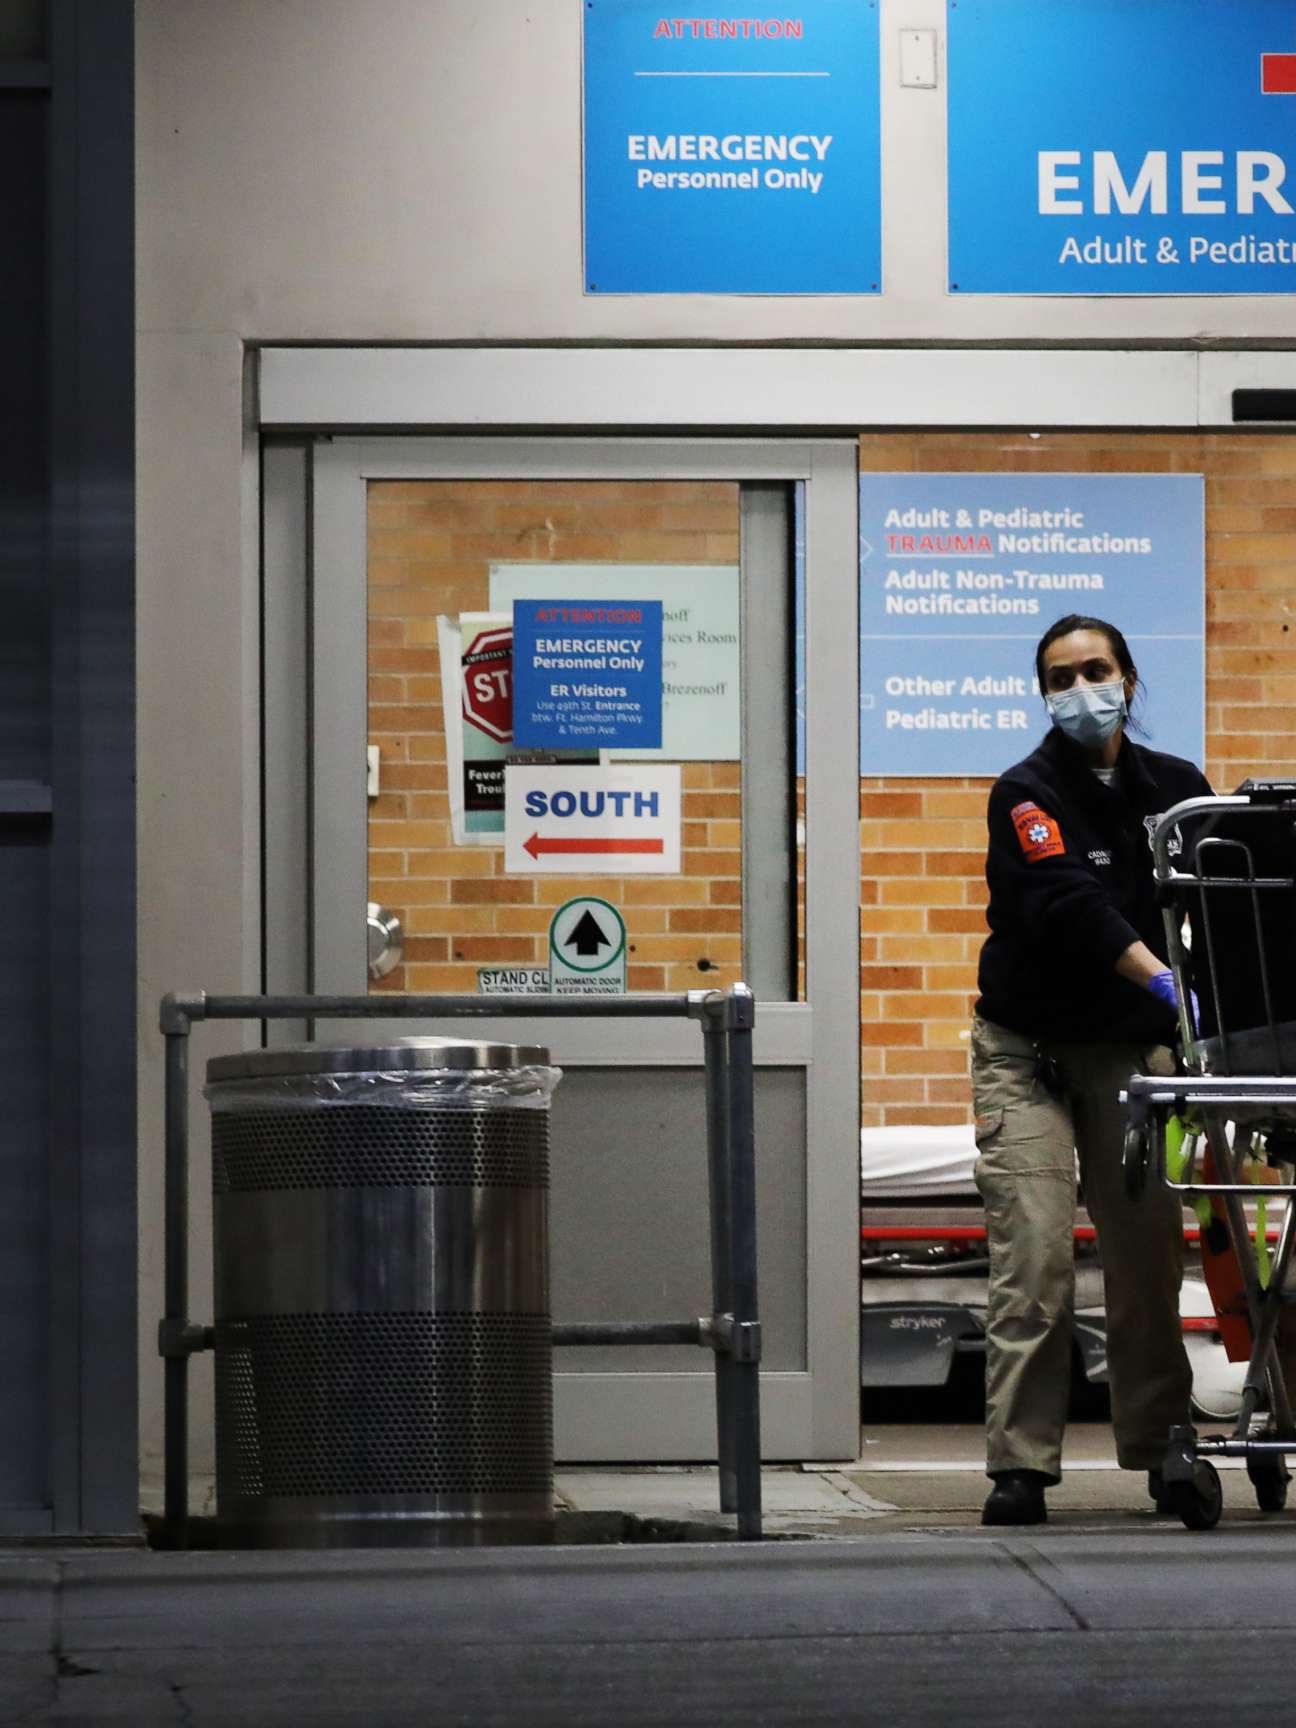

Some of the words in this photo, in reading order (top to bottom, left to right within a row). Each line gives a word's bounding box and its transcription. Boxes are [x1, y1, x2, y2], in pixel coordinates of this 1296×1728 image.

[654, 18, 803, 39] ATTENTION
[629, 135, 832, 160] EMERGENCY
[638, 168, 759, 188] Personnel
[764, 168, 823, 193] Only
[1059, 236, 1147, 264] Adult
[1156, 237, 1179, 263] &
[884, 508, 950, 528] Adult
[956, 509, 972, 528] &
[979, 508, 1083, 528] Pediatric
[885, 534, 992, 553] TRAUMA
[999, 533, 1151, 553] Notifications
[884, 569, 950, 589] Adult
[956, 570, 1104, 589] Non-Trauma
[886, 593, 1039, 614] Notifications
[535, 608, 642, 623] ATTENTION
[534, 639, 641, 653] EMERGENCY
[697, 631, 737, 643] Room
[532, 656, 607, 668] Personnel
[608, 657, 645, 671] Only
[473, 669, 510, 703] ST
[550, 685, 570, 696] ER
[571, 684, 627, 697] Visitors
[885, 676, 956, 696] Other
[960, 676, 1025, 696] Adult
[595, 701, 640, 711] Entrance
[571, 713, 615, 723] Hamilton
[886, 708, 991, 729] Pediatric
[997, 710, 1027, 729] ER
[559, 725, 566, 735] &
[569, 725, 596, 735] Tenth
[525, 791, 658, 817] SOUTH
[482, 971, 528, 985] STAND
[531, 971, 550, 985] CL
[555, 977, 597, 985] AUTOMATIC
[889, 1316, 946, 1330] stryker
